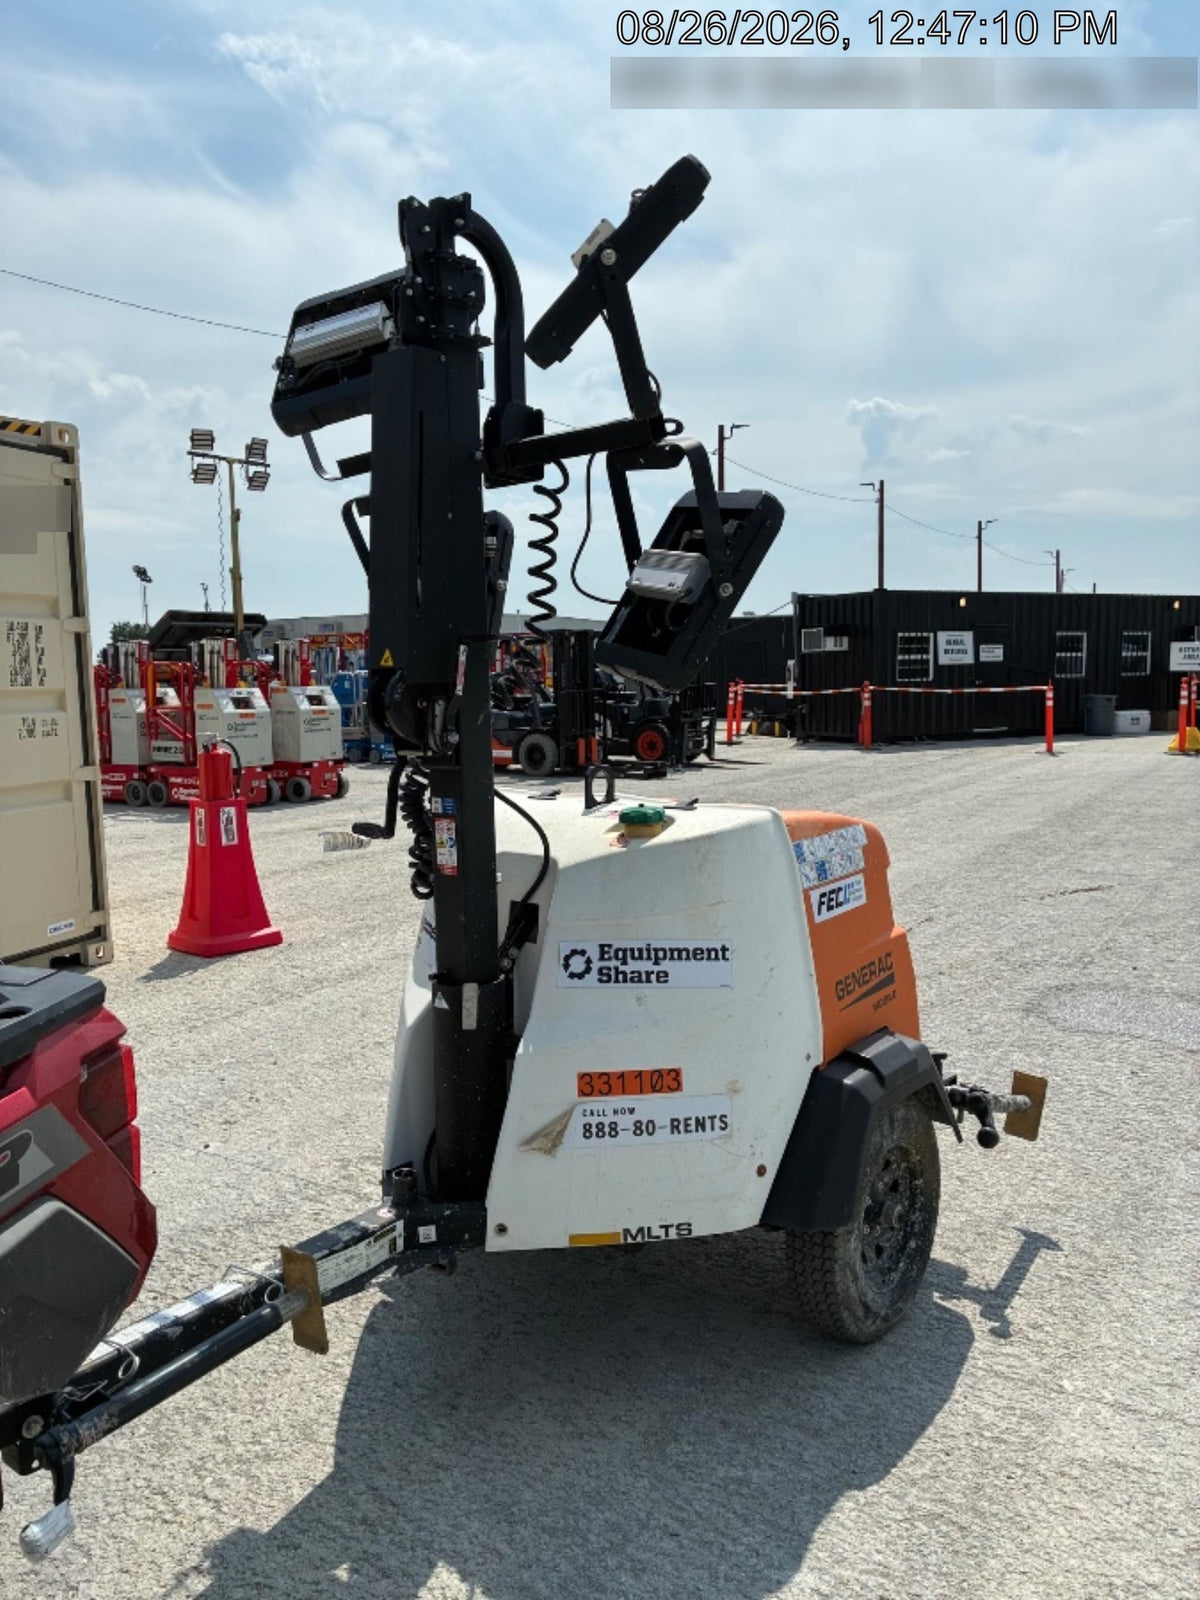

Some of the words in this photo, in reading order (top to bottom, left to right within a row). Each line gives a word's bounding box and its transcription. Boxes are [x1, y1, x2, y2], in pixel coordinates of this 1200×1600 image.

[598, 944, 729, 966] Equipment
[597, 965, 670, 984] Share
[835, 952, 894, 1001] GENERAC
[872, 989, 897, 1011] MOBILE
[579, 1068, 681, 1097] 331103
[581, 1108, 608, 1118] CALL
[612, 1107, 636, 1116] NOW
[582, 1114, 729, 1140] 888-80-RENTS
[622, 1222, 693, 1242] MLTS
